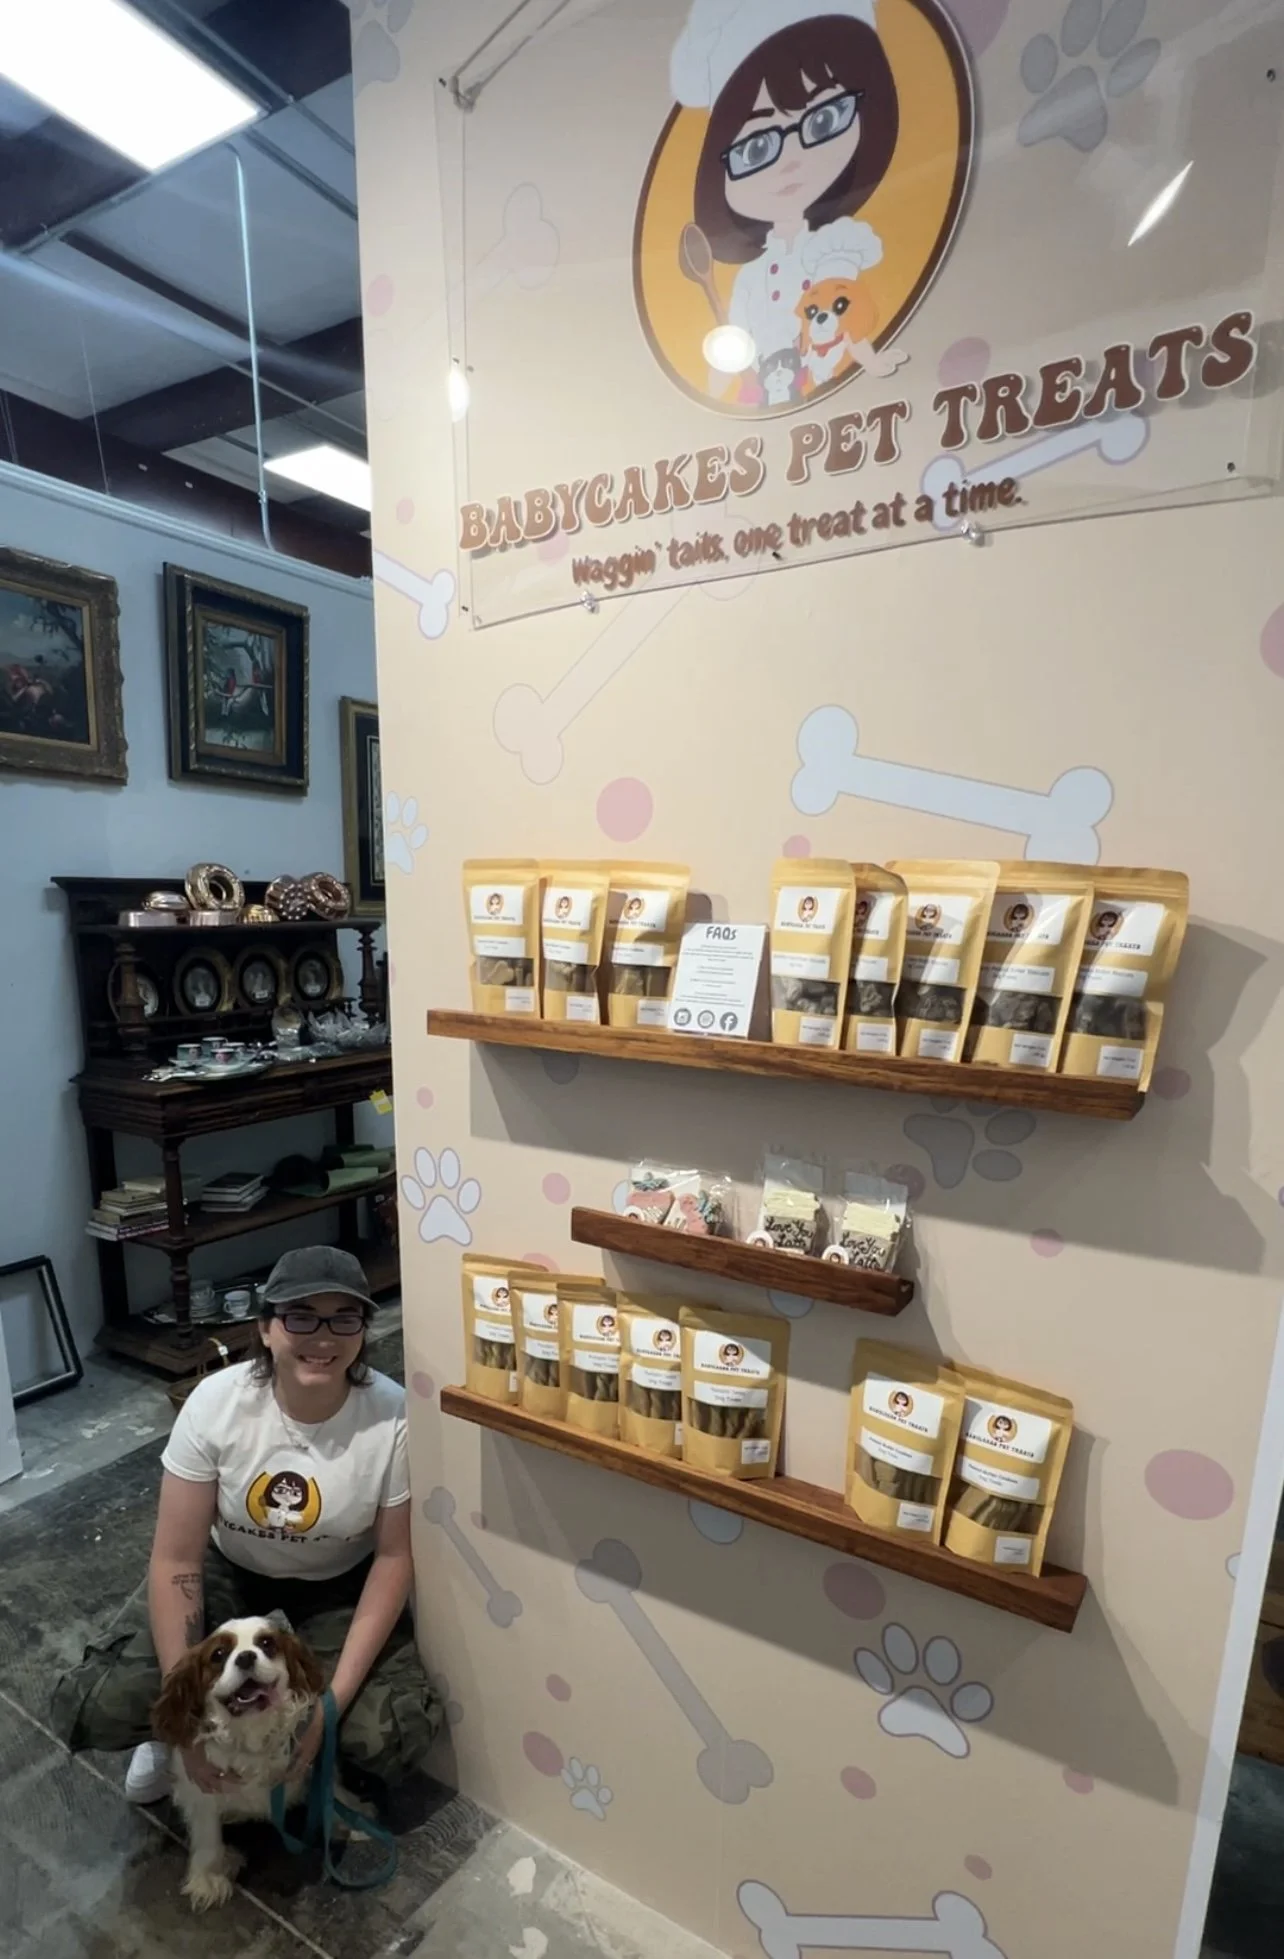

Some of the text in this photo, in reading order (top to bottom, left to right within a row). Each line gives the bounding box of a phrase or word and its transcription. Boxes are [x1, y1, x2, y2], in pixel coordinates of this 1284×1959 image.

[459, 309, 1258, 551] BABYCAKES PET TREATS
[571, 540, 662, 591] Waggin'
[733, 520, 783, 558] one
[786, 511, 867, 547] treat
[871, 492, 907, 530] at
[913, 493, 934, 523] a
[942, 476, 1024, 518] time.
[706, 926, 738, 940] FAQs
[281, 1534, 307, 1543] PET
